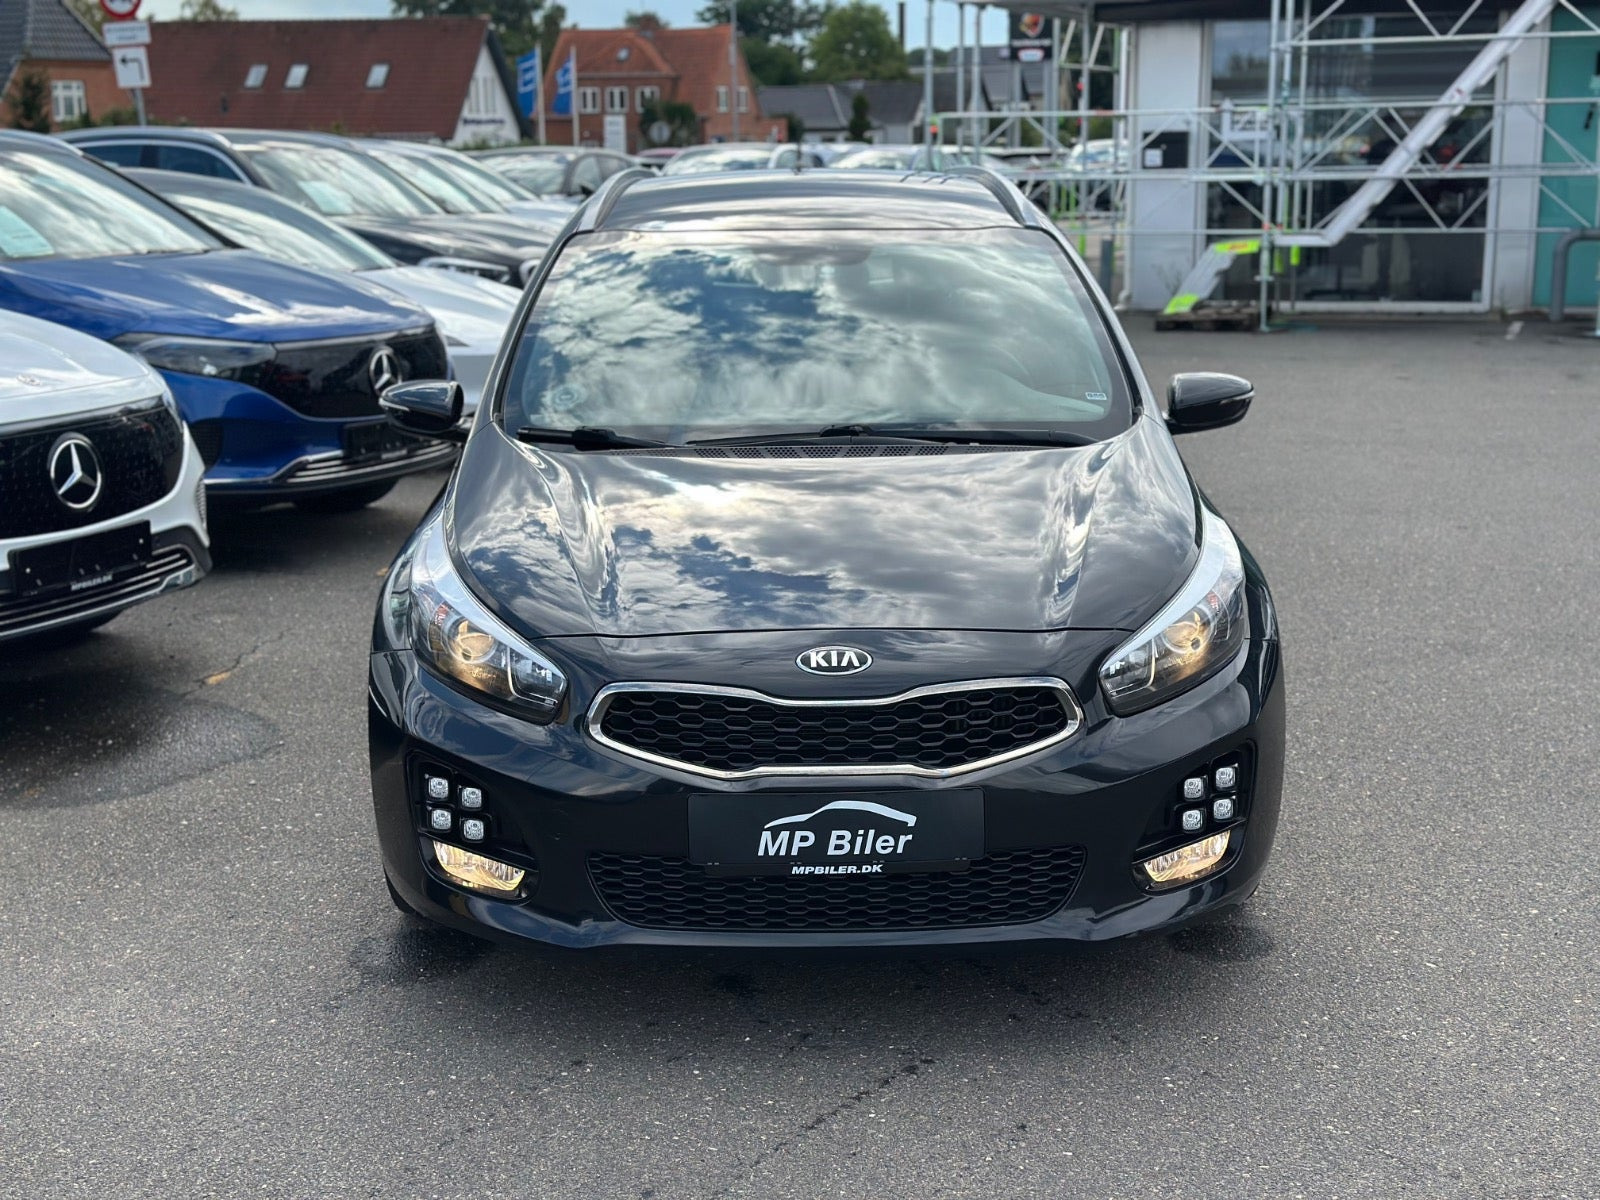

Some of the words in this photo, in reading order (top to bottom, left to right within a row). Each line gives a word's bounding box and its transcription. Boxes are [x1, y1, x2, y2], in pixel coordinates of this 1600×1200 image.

[809, 650, 860, 668] KIA
[757, 830, 816, 856] MP
[827, 829, 913, 856] Biler
[791, 864, 883, 875] MPBILER.DK
